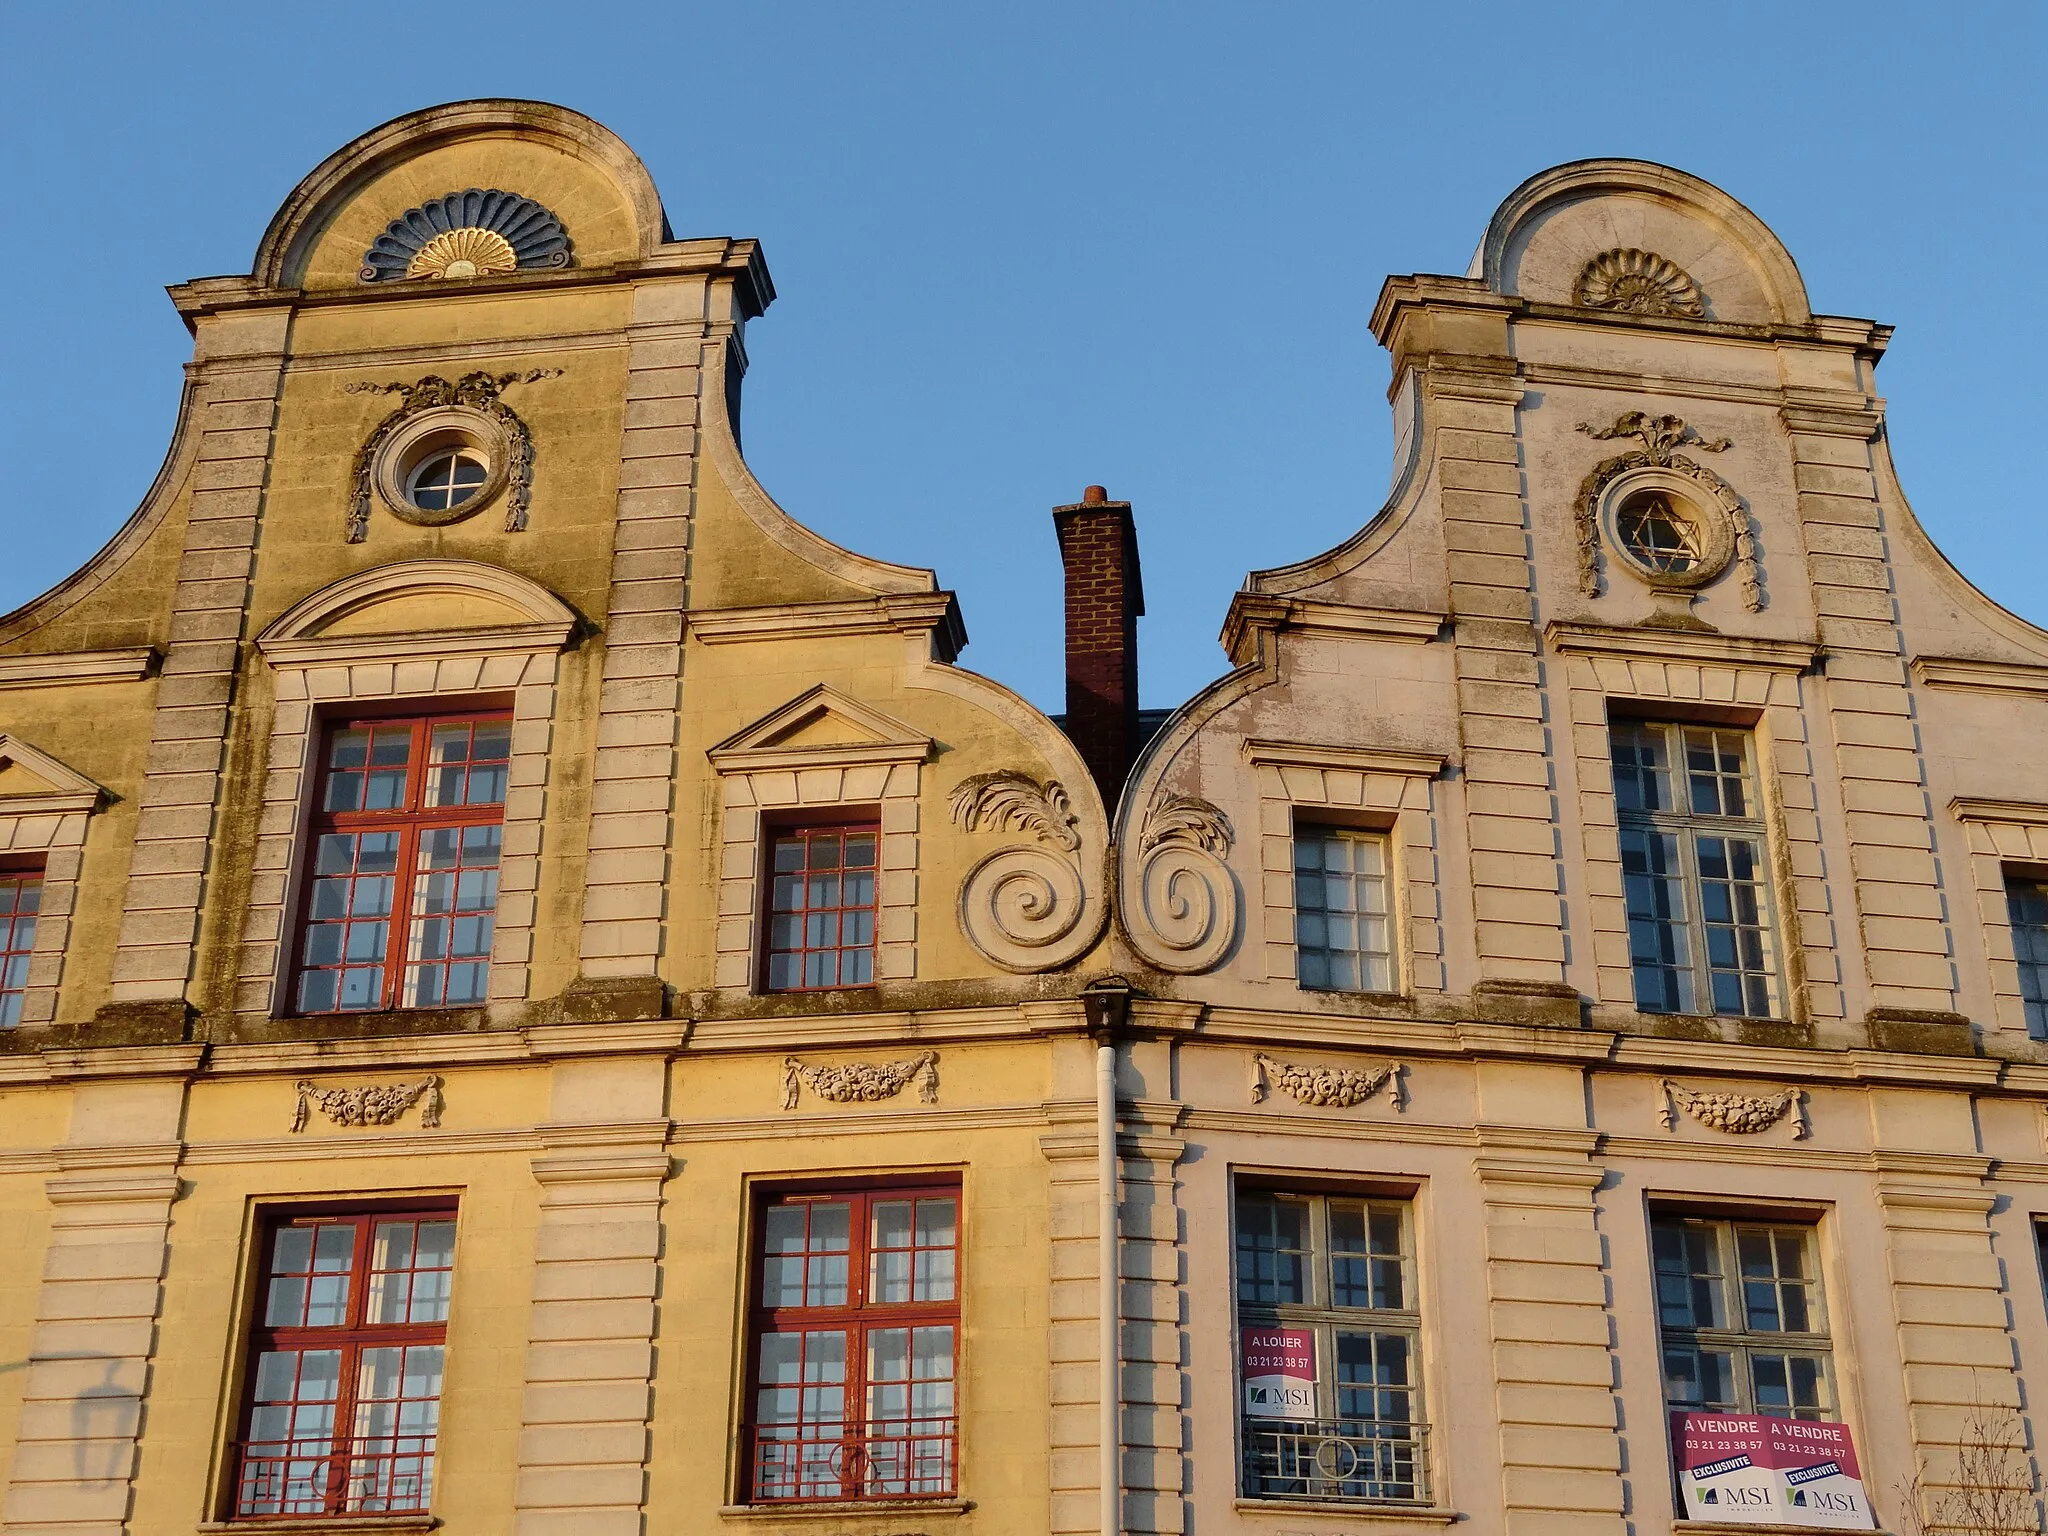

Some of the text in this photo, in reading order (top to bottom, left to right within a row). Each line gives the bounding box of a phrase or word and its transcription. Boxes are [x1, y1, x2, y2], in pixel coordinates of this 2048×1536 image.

[1252, 1337, 1302, 1348] A LOUER
[1247, 1356, 1308, 1368] 03 21 23 38 57
[1273, 1388, 1310, 1406] MSI
[1684, 1419, 1759, 1433] A VENDRE
[1771, 1423, 1842, 1442] A VENDRE
[1686, 1440, 1762, 1450] 03 21 23 38 57
[1774, 1442, 1846, 1458] 03 21 23 38 57
[1693, 1456, 1750, 1478] EXCLUSIVITE
[1788, 1463, 1840, 1483] EXCLUSIVITE
[1724, 1487, 1772, 1505] MSI
[1812, 1490, 1858, 1512] MSI
